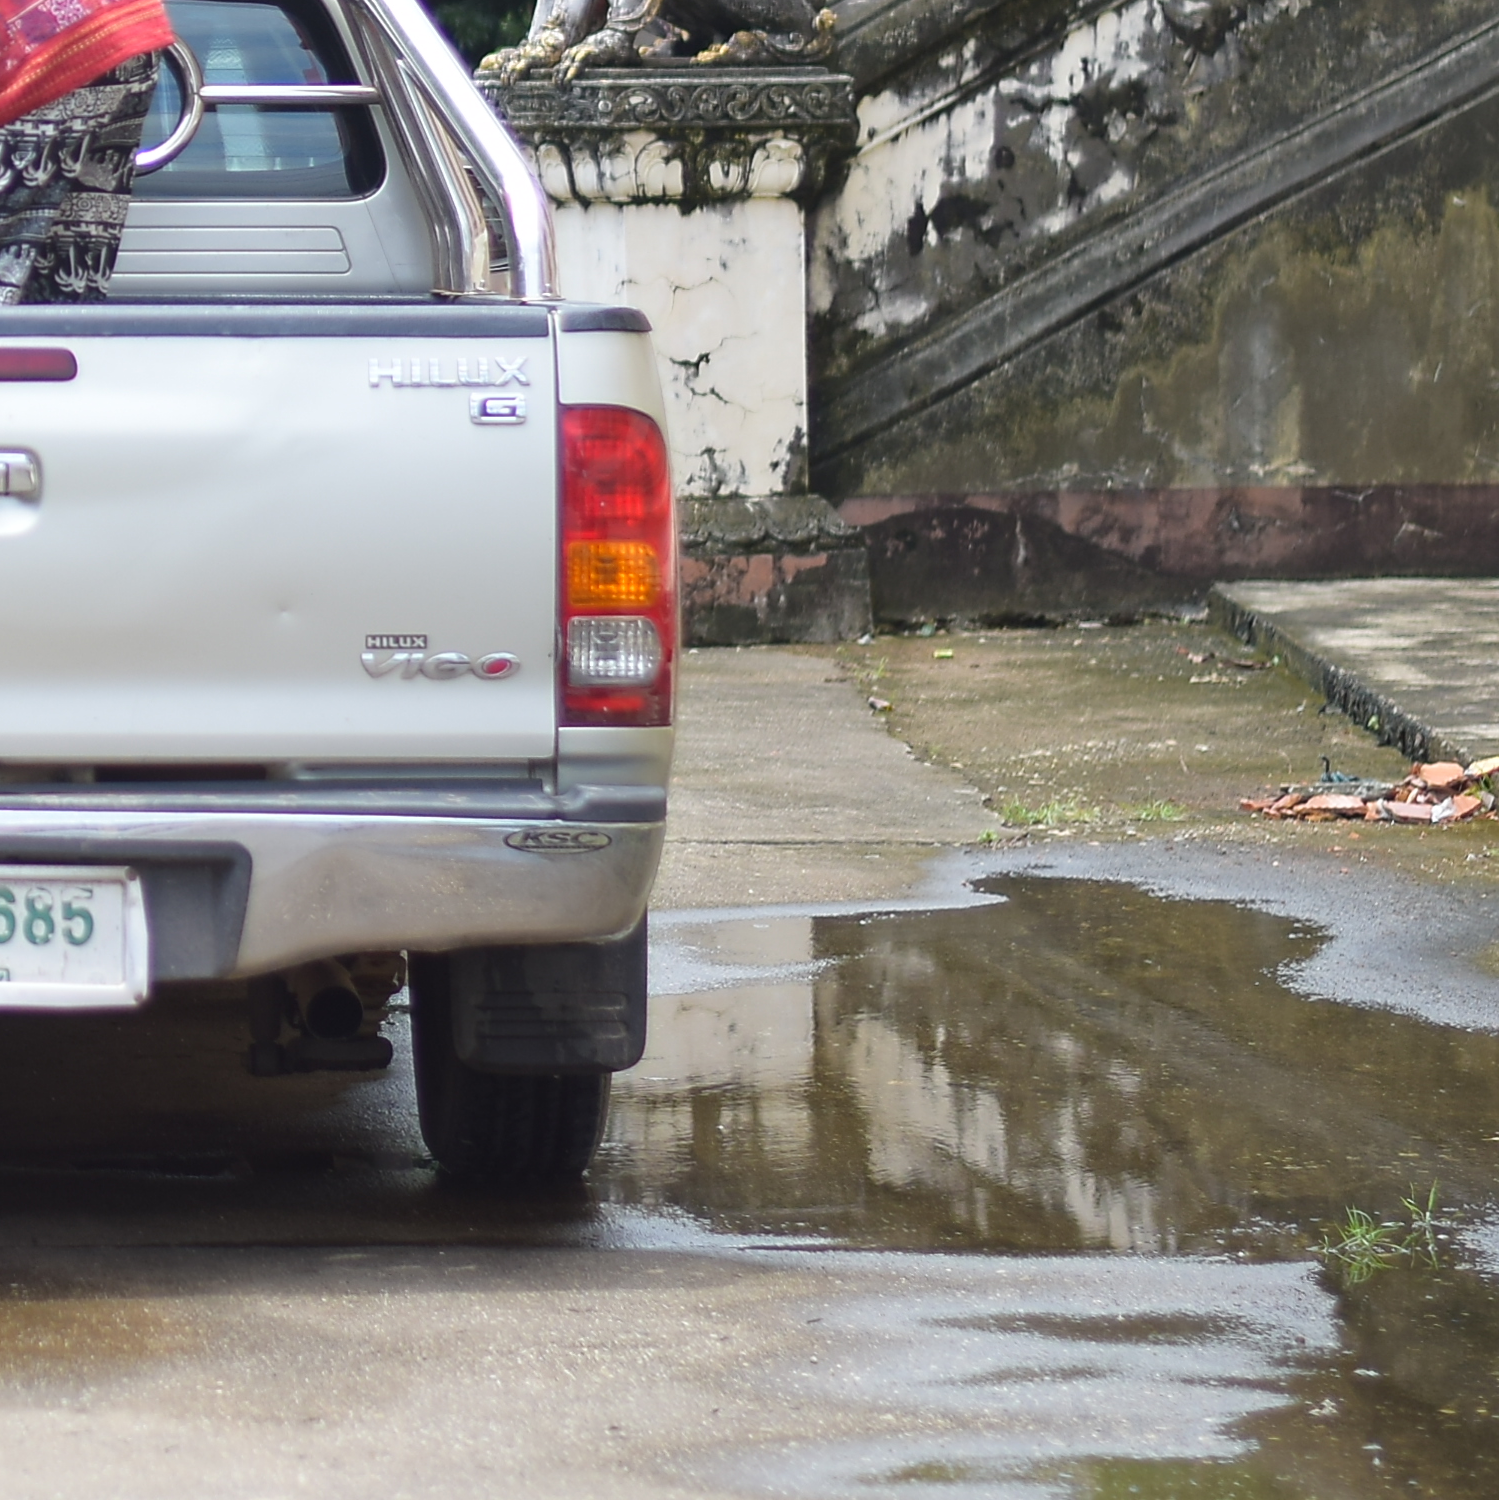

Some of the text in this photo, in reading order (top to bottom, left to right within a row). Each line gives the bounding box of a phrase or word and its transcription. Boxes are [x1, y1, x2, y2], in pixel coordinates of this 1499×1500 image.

[368, 357, 530, 387] HILUX
[477, 395, 520, 420] G
[366, 636, 426, 648] HILUX
[521, 831, 599, 846] KSC
